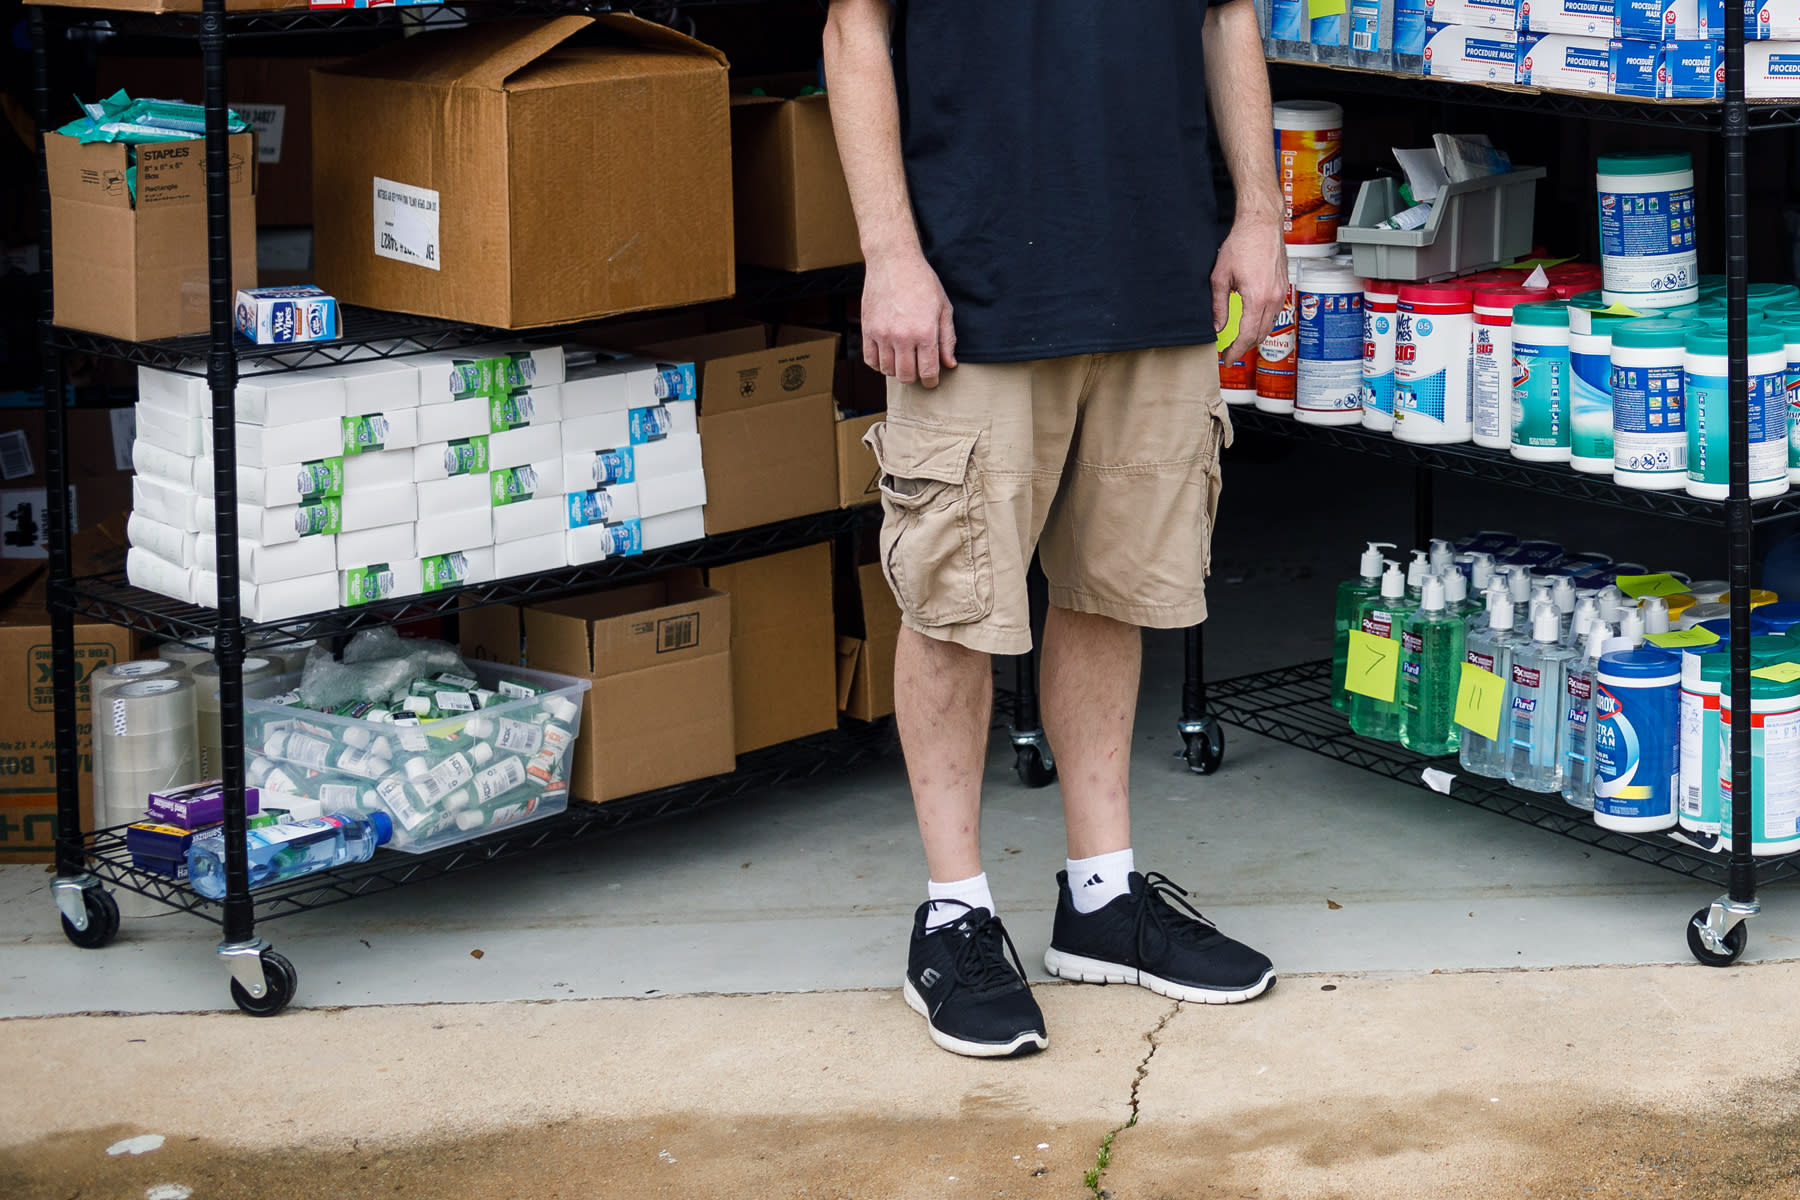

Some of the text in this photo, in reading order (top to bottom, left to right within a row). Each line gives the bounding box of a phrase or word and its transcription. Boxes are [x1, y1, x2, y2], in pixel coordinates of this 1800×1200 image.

[1565, 1, 1614, 12] PROCEDURE MASK
[1631, 2, 1661, 10] PROCEDURE
[1645, 10, 1661, 18] MASK
[1466, 47, 1514, 60] PROCEDURE MASK
[1566, 56, 1599, 67] PROCEDURE
[1626, 57, 1654, 66] PROCEDURE
[1681, 58, 1711, 67] PROCEDURE
[1639, 65, 1653, 73] MASK
[1695, 65, 1710, 74] MASK
[144, 147, 189, 161] STAPLES
[274, 310, 284, 333] Wet
[283, 306, 294, 341] Wipes
[1376, 320, 1388, 330] 65
[1417, 321, 1431, 331] 65
[1476, 344, 1493, 354] BIG
[1403, 662, 1420, 673] Purell
[1514, 698, 1535, 712] Purell
[1569, 709, 1587, 724] Purell
